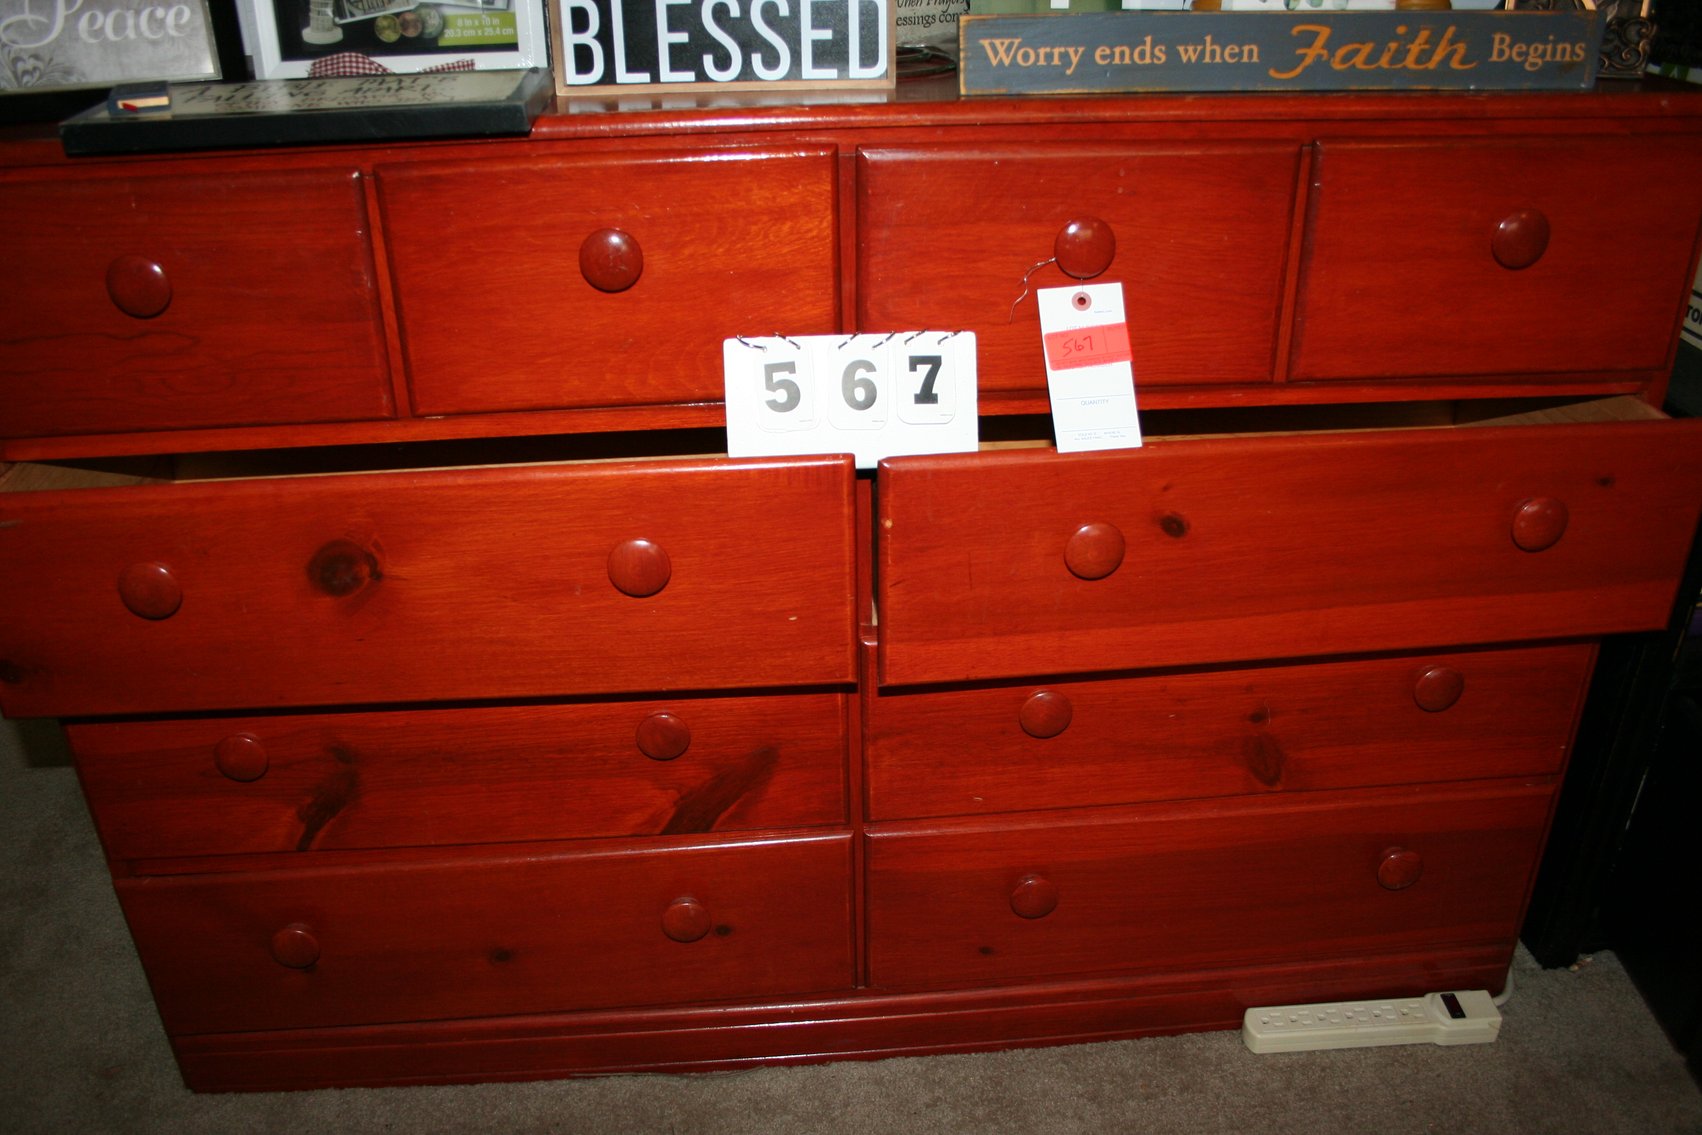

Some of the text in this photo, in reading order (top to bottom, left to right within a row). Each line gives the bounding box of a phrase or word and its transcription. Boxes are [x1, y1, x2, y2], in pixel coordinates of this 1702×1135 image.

[462, 29, 476, 37] cm
[501, 27, 514, 36] cm
[566, 0, 888, 85] BLESSED
[979, 23, 1586, 80] Worry ends when Faith Begins
[1685, 304, 1702, 326] TO
[1062, 335, 1094, 358] 567
[1080, 399, 1110, 407] QUANTITY
